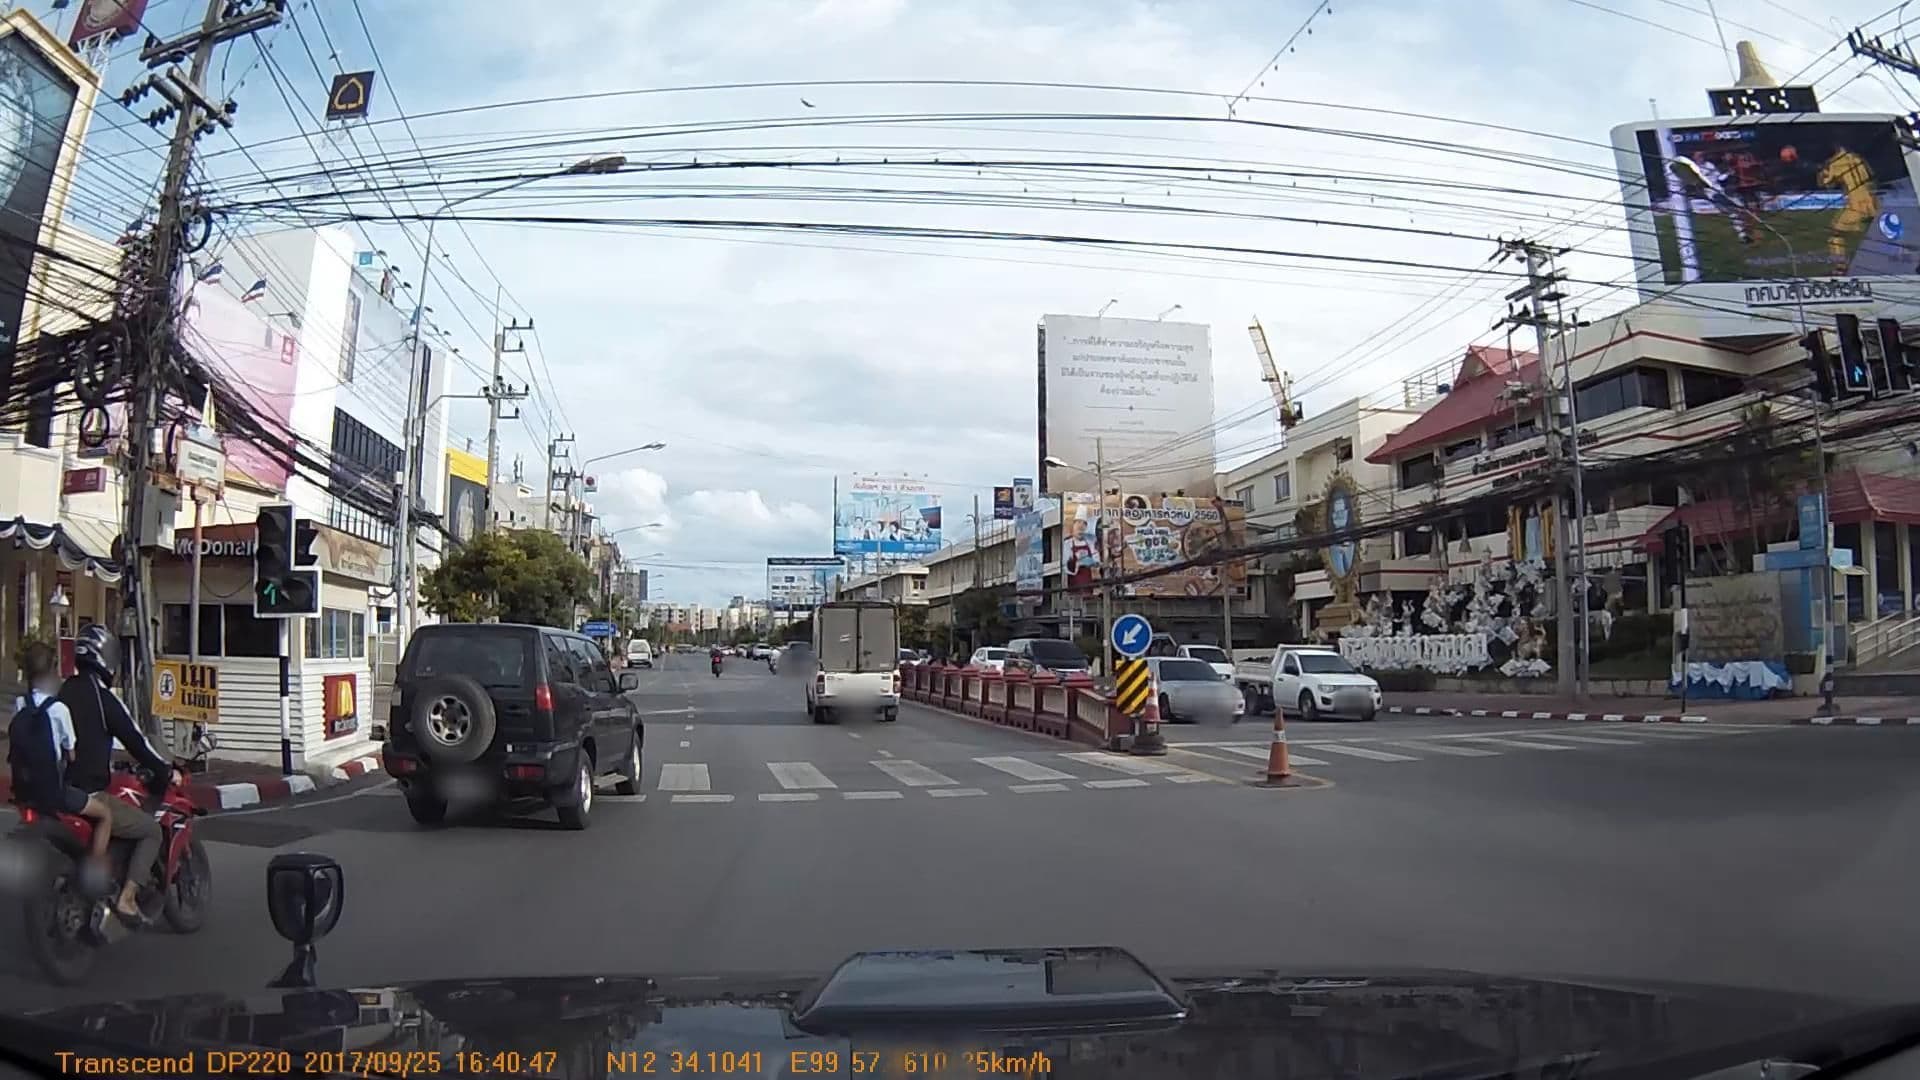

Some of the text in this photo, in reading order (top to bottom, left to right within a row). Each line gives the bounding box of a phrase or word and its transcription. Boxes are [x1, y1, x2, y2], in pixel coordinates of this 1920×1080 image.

[1194, 510, 1219, 521] 2560
[180, 663, 217, 689] เมา
[181, 688, 217, 709] ไม่ขับ
